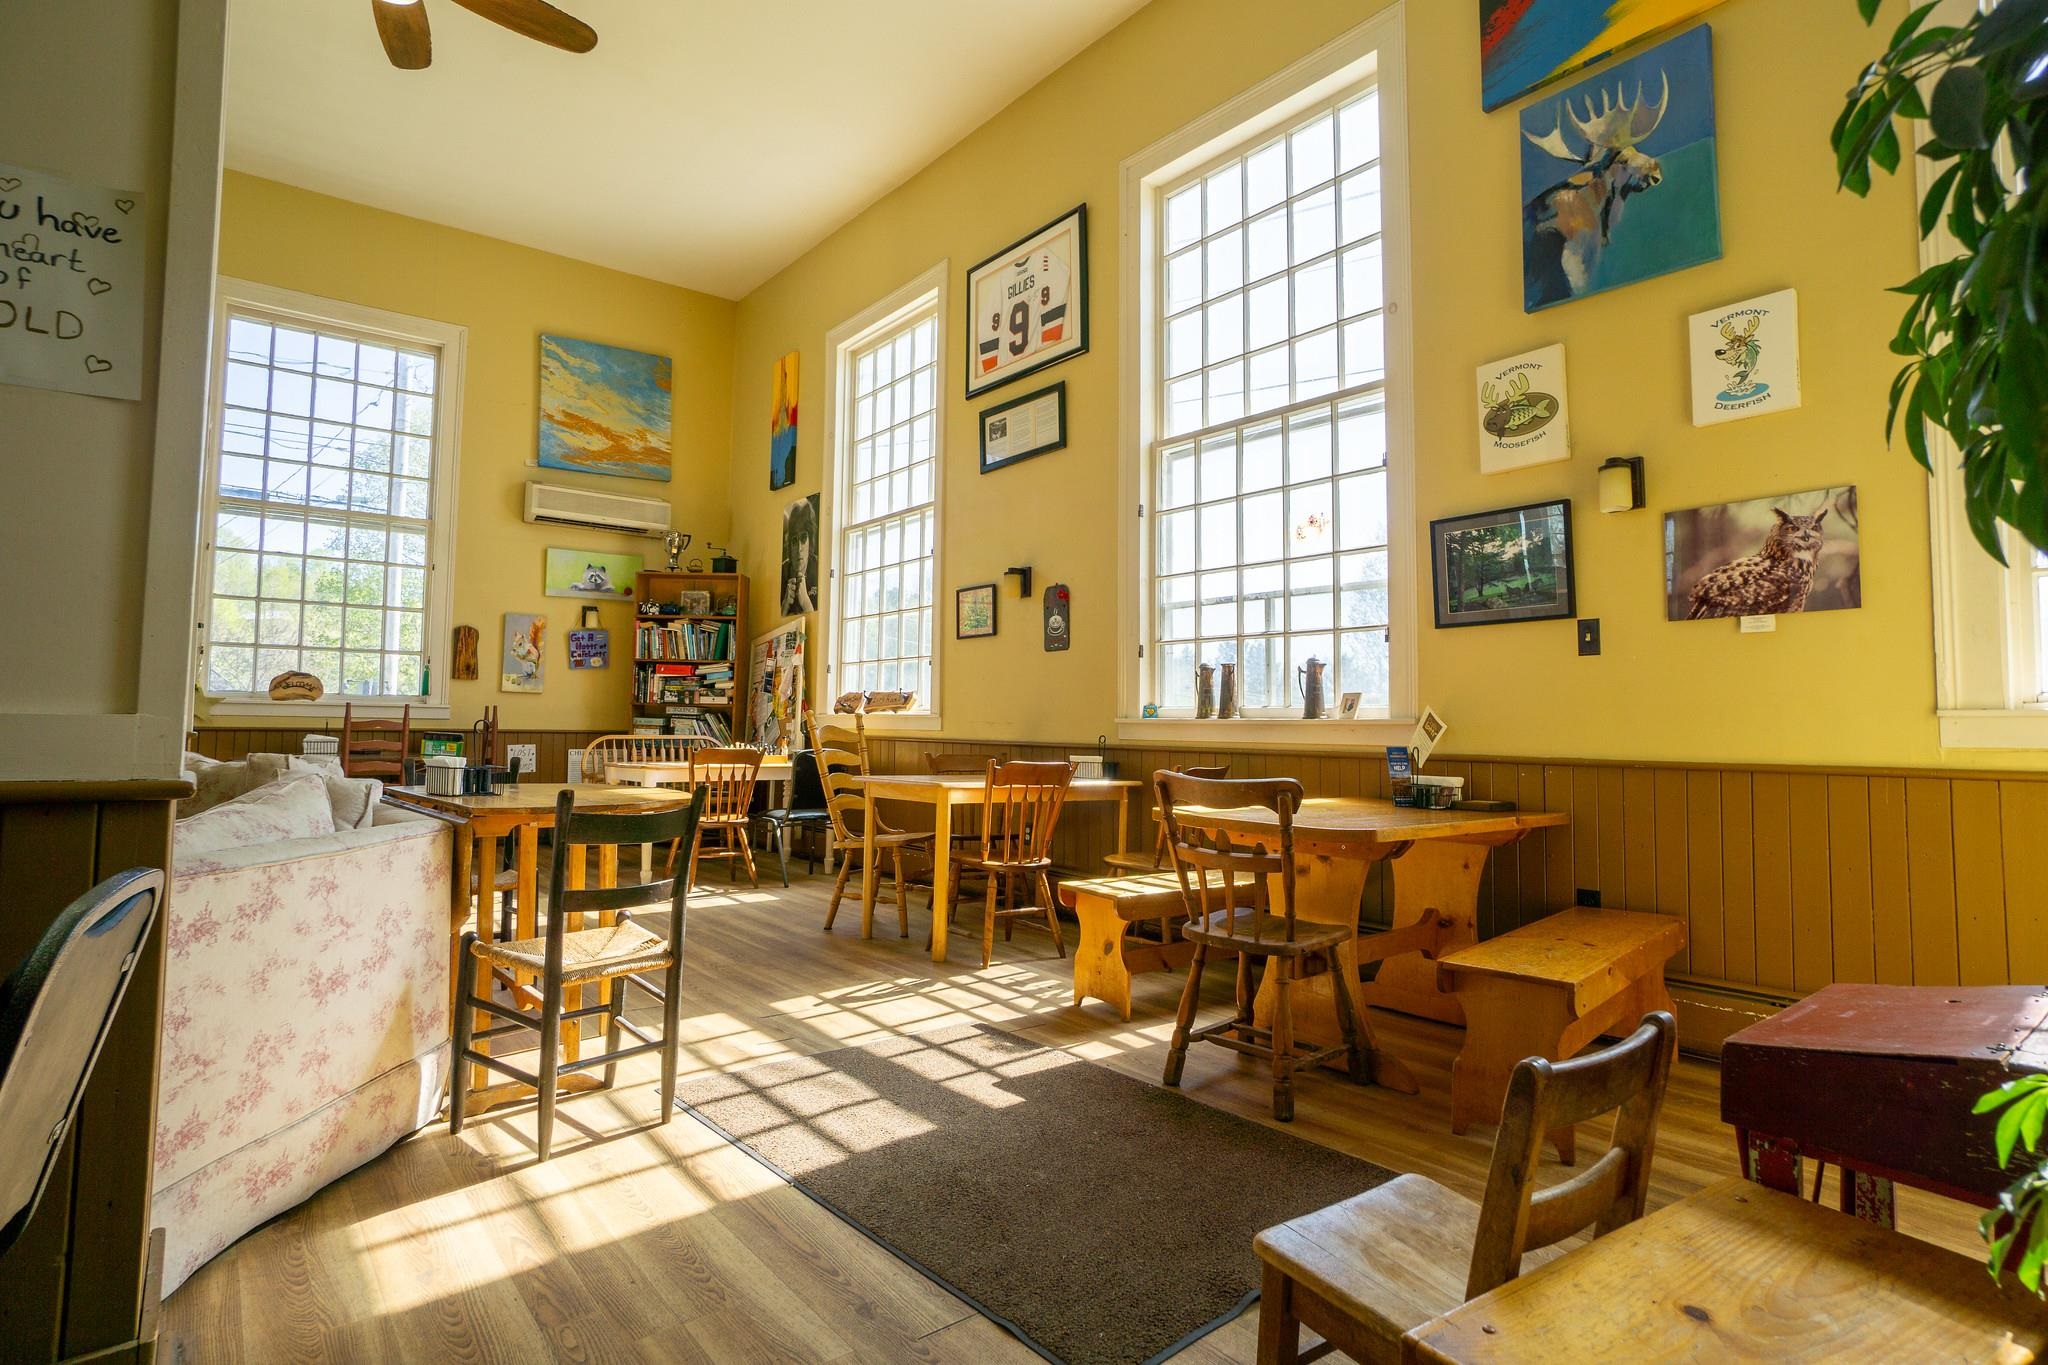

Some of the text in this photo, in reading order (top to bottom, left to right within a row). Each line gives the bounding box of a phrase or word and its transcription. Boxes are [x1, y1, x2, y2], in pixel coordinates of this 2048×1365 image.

[37, 196, 122, 244] have
[0, 267, 31, 290] of
[1008, 274, 1035, 299] GILLIES
[1041, 285, 1050, 306] 9
[992, 312, 1000, 332] 9
[1009, 301, 1030, 356] 9
[1710, 308, 1771, 329] VERMONT
[1495, 362, 1543, 381] VERMONT
[1714, 391, 1772, 411] DEERFISH
[1493, 430, 1547, 449] MOOSEFISH
[512, 748, 532, 757] LOST
